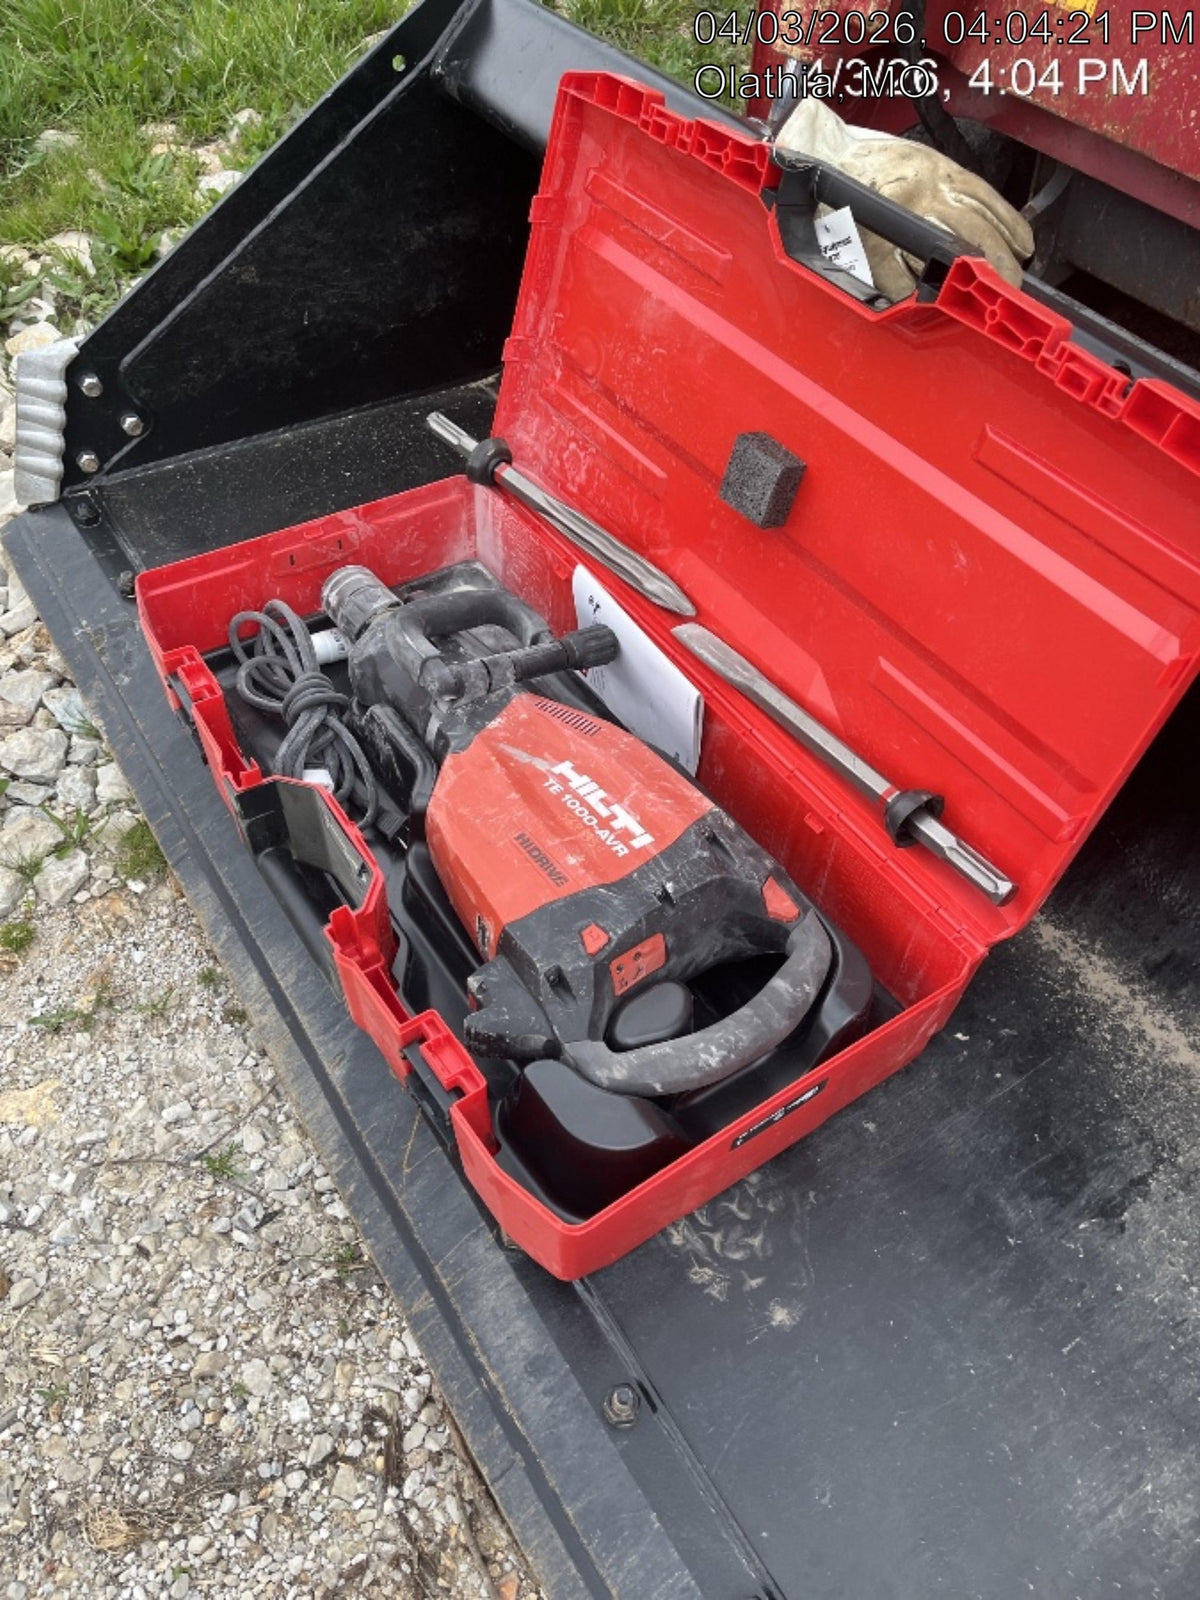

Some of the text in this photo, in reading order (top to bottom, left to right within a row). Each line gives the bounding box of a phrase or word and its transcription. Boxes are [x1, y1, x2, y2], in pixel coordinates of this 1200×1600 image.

[543, 778, 630, 858] TE 1000-AVR
[551, 760, 656, 849] HILTI
[513, 832, 569, 888] HIDRIVE
